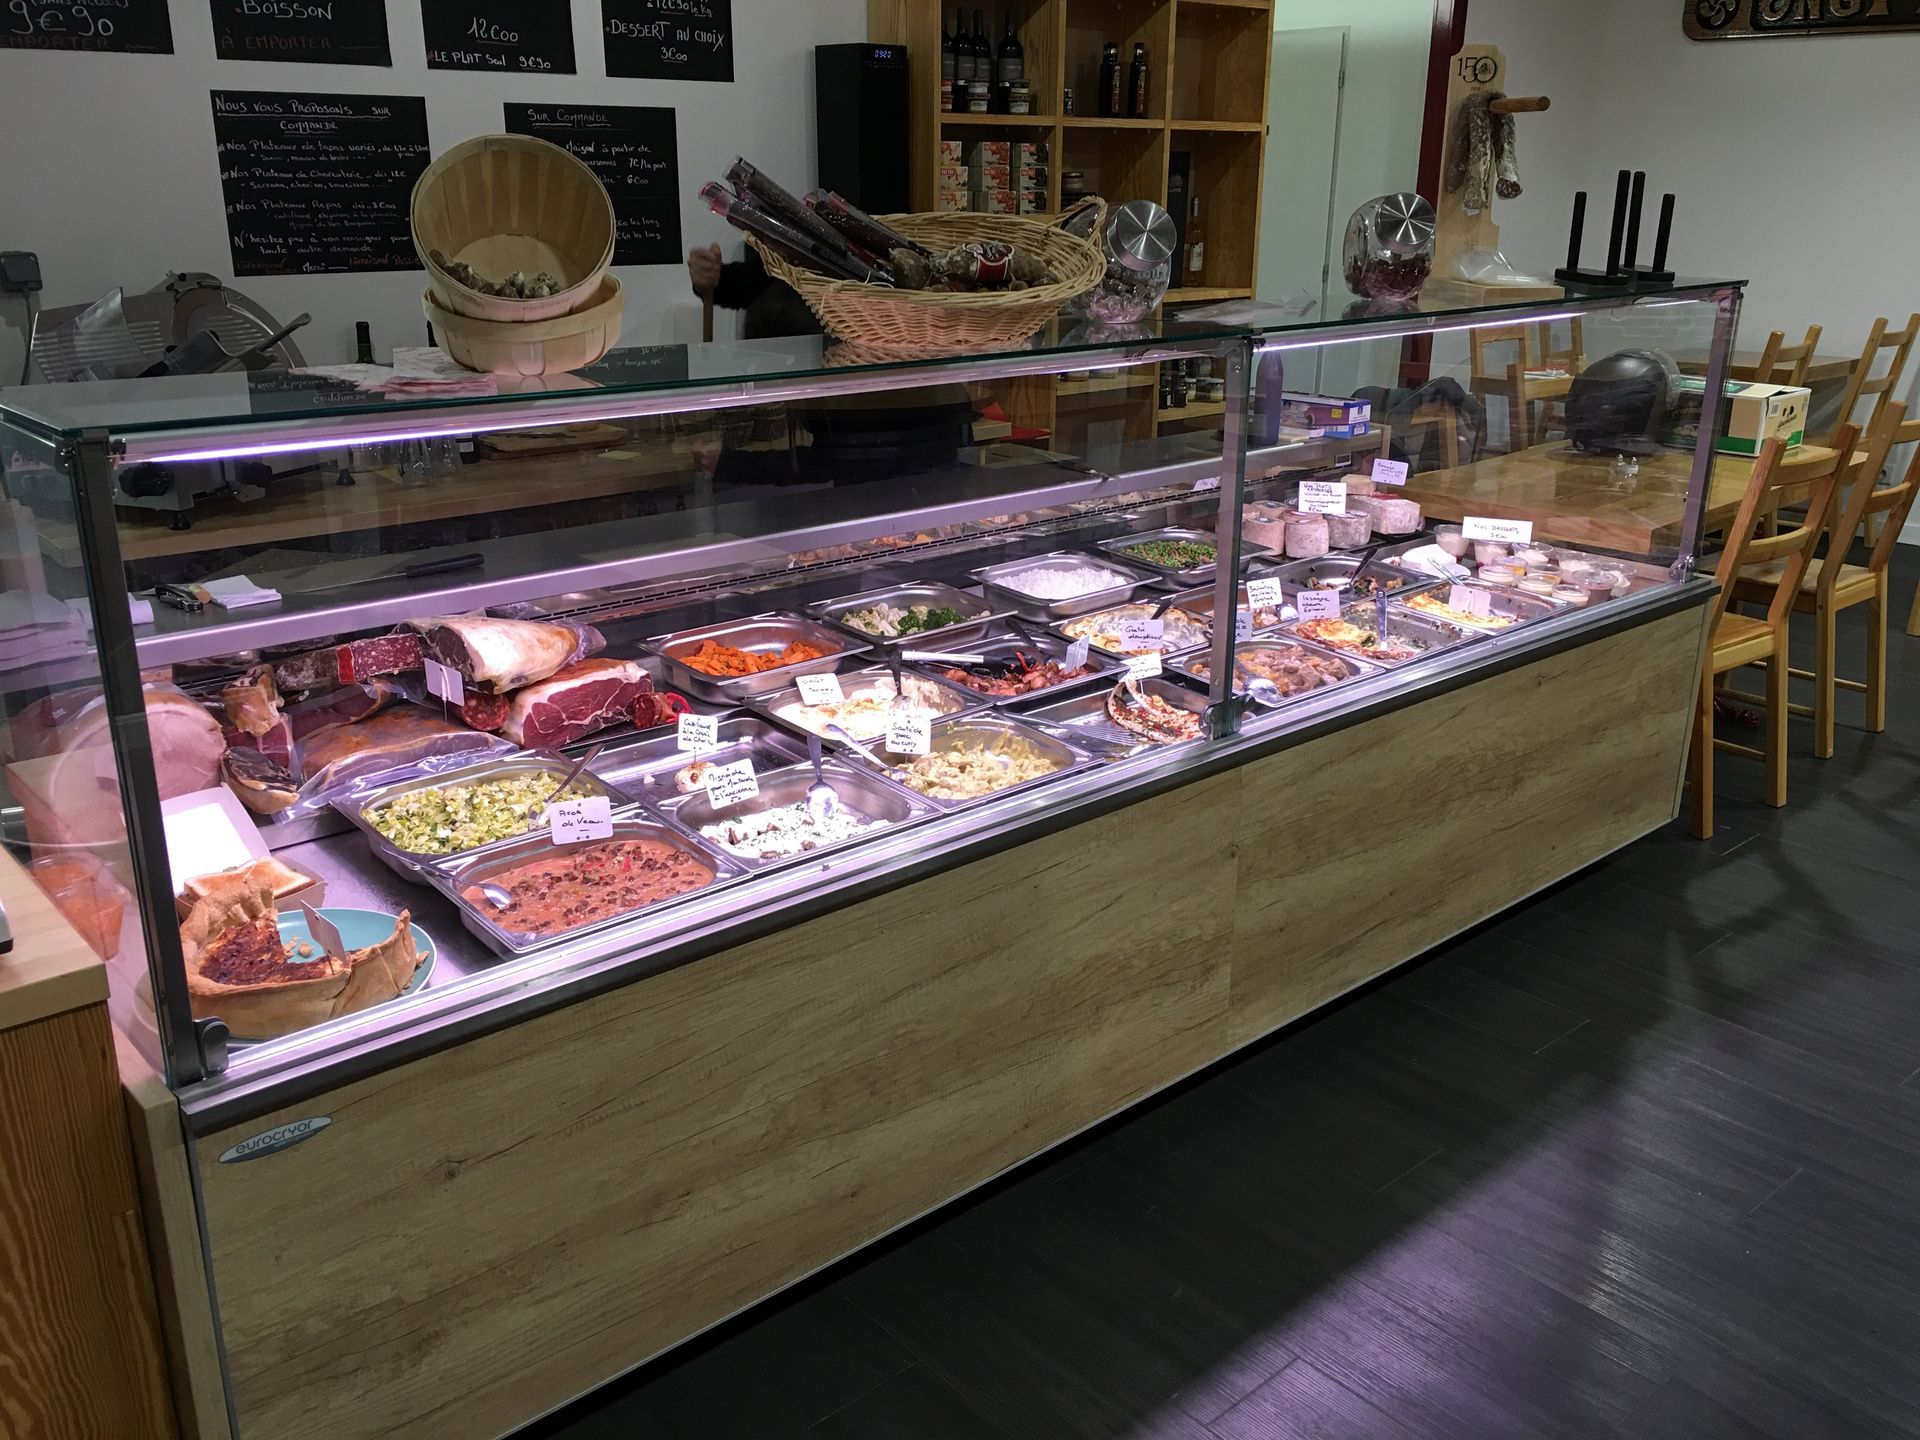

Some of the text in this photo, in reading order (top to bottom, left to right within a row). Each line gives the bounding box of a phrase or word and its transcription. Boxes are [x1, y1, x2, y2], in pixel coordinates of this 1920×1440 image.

[610, 19, 670, 41] DESSERT
[677, 27, 689, 41] AU
[434, 50, 449, 62] LE
[452, 50, 482, 65] PLAT
[519, 56, 551, 69] 9€90
[660, 47, 688, 61] 3€00
[1457, 56, 1497, 83] 150
[372, 106, 391, 117] SUR
[280, 120, 338, 134] COMMANDE
[249, 140, 297, 151] Plateaux
[235, 1119, 312, 1154] eurocryor
